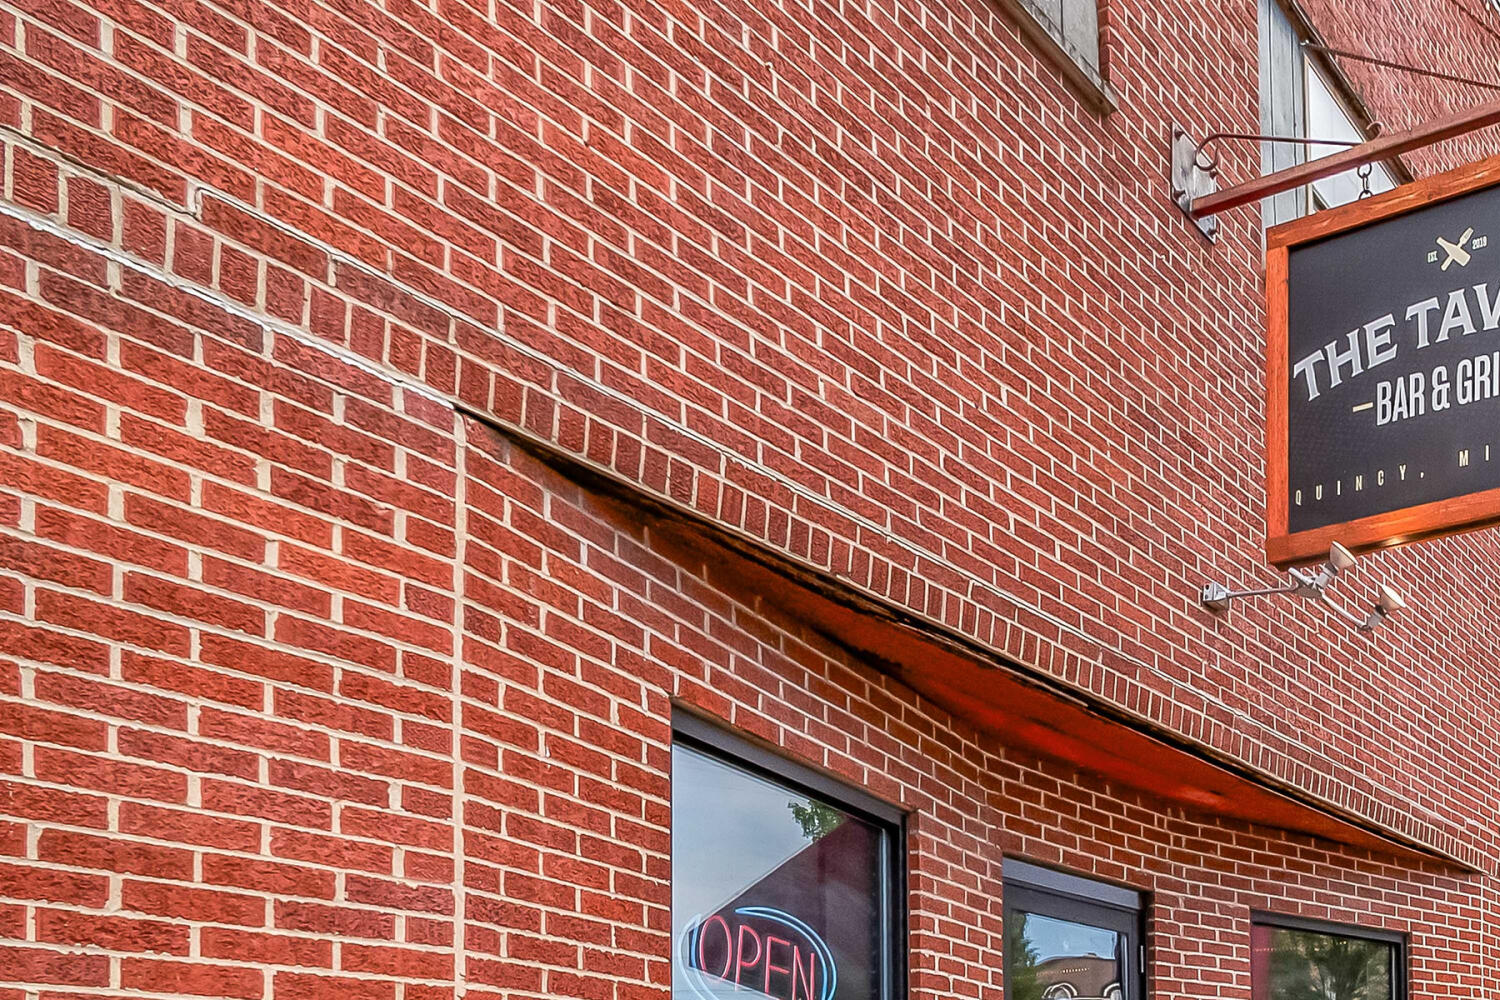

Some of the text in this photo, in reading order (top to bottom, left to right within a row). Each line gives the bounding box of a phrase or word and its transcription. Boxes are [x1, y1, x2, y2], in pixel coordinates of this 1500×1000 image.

[1293, 313, 1400, 402] THE
[1376, 372, 1425, 427] BAR
[1432, 365, 1451, 410] &
